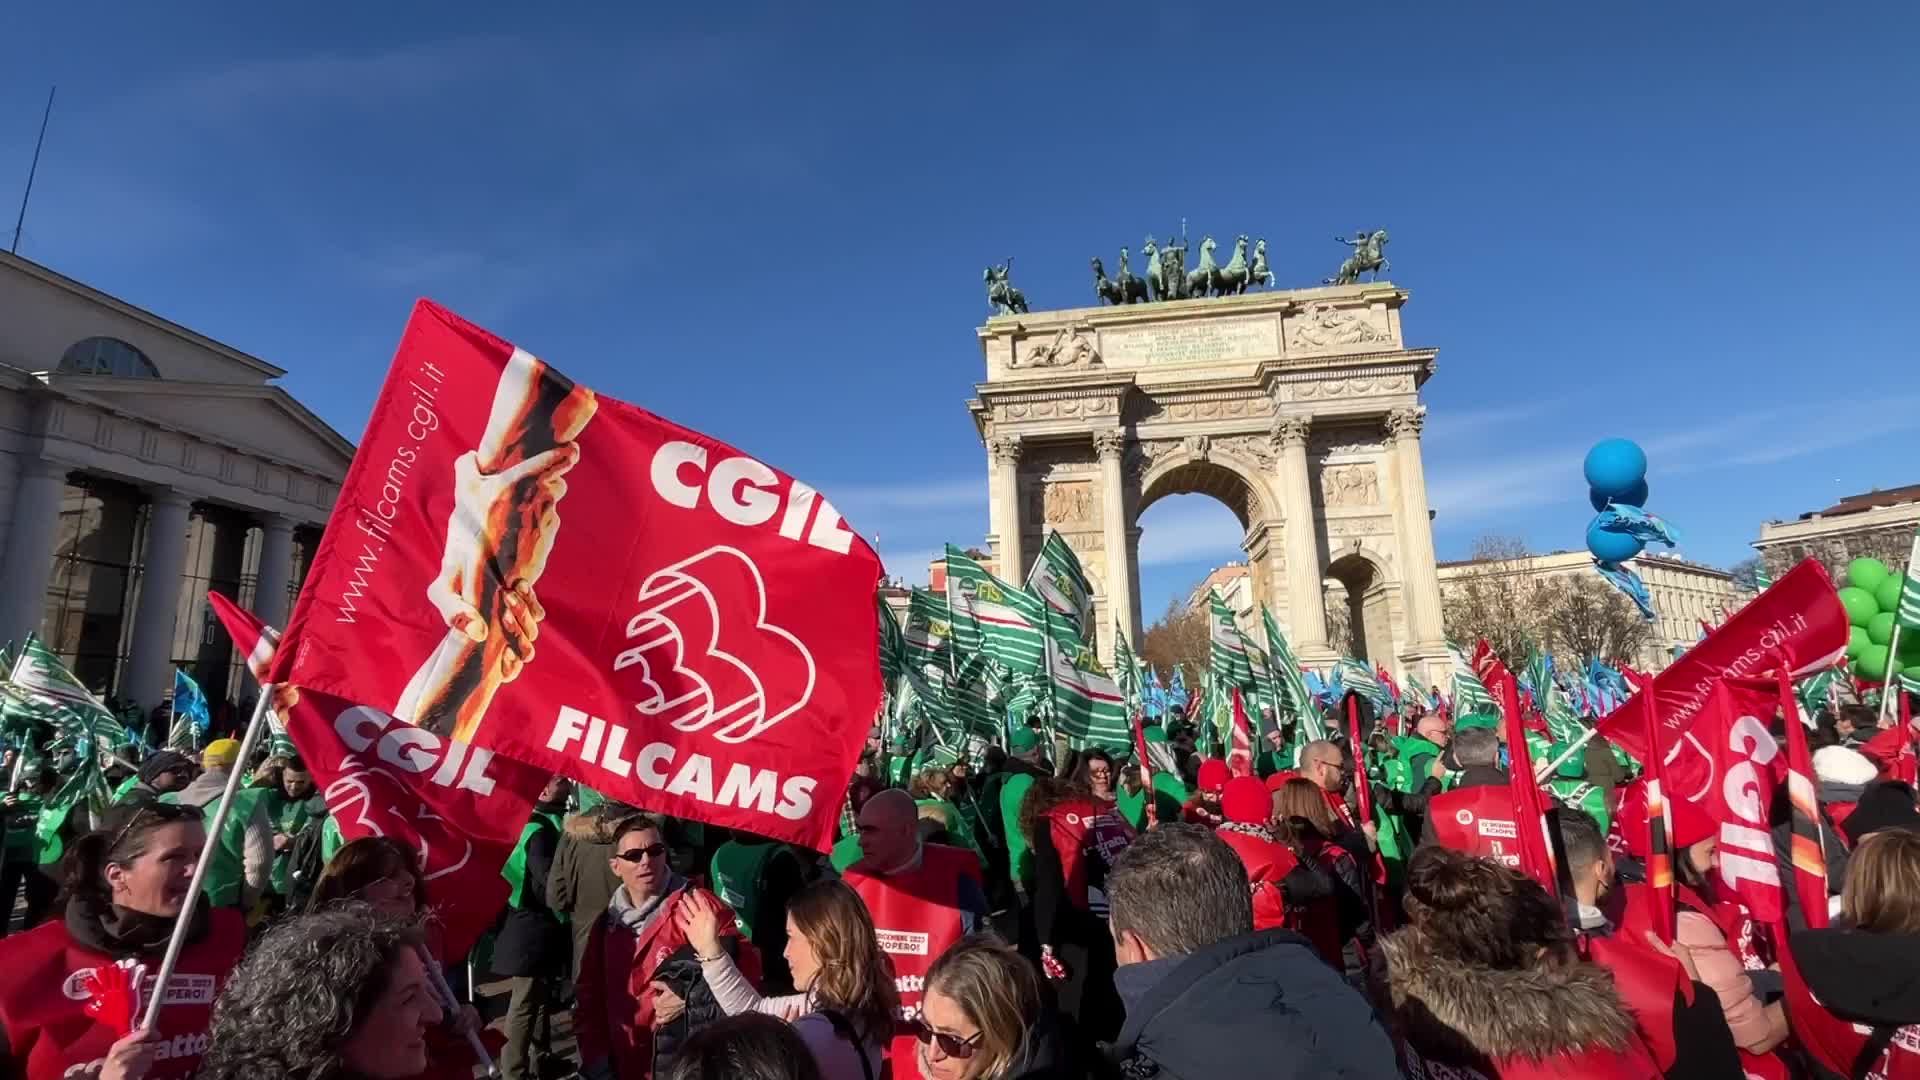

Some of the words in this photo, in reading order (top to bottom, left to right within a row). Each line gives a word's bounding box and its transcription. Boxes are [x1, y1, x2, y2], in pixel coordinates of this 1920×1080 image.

[336, 361, 444, 624] www.filcams.cgil.it
[650, 440, 854, 555] CGIL
[334, 705, 496, 797] CGIL
[546, 704, 818, 820] FILCAMS
[1720, 715, 1782, 892] CGIL
